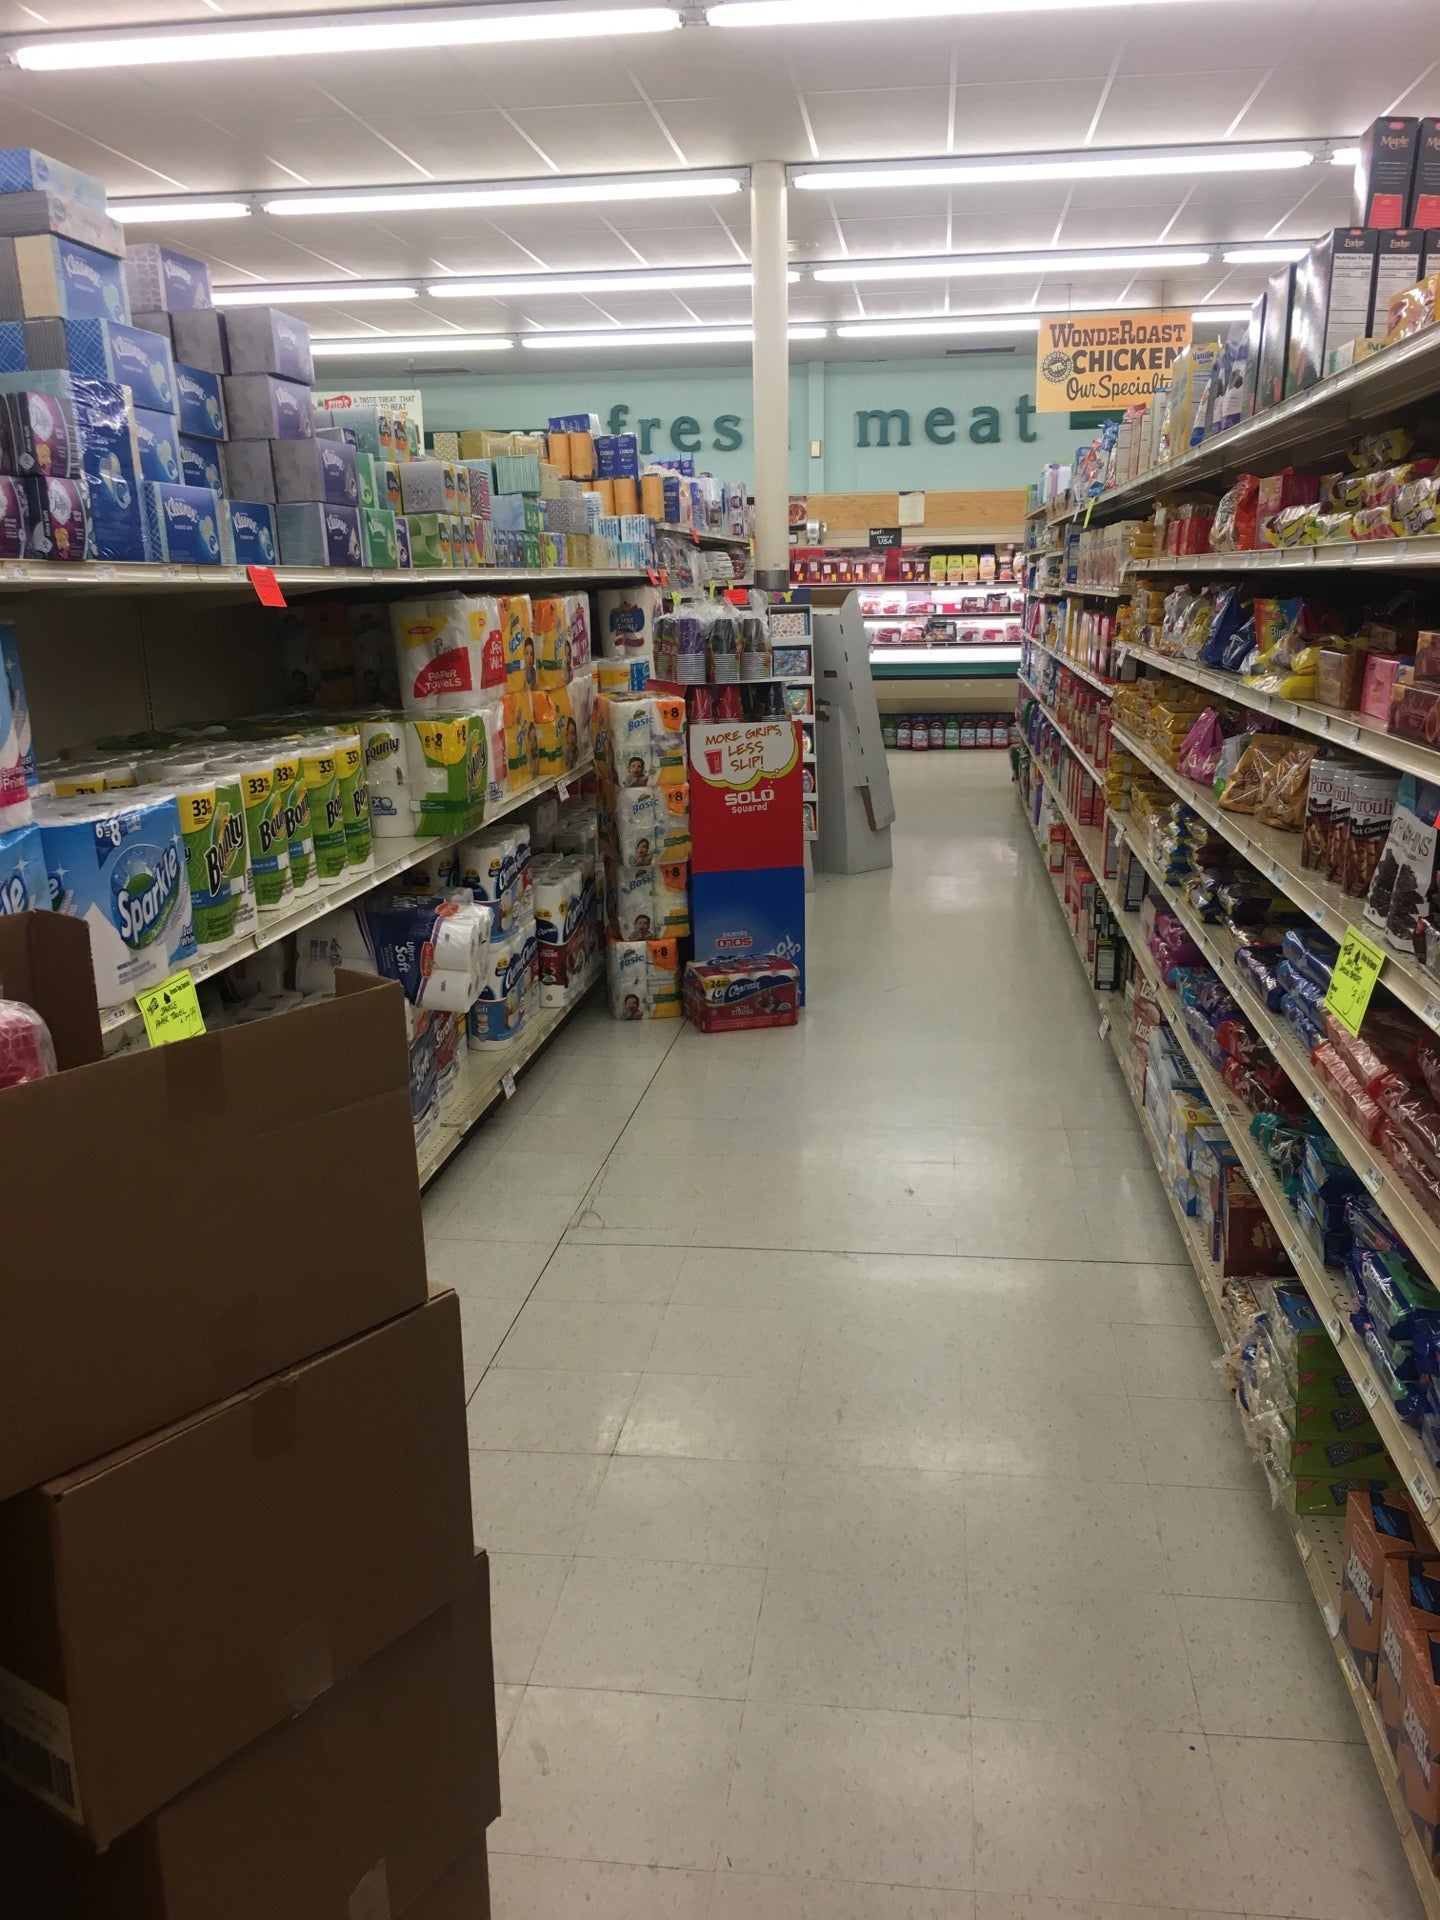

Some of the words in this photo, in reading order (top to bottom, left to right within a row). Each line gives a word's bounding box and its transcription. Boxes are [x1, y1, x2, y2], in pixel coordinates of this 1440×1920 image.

[1380, 136, 1410, 151] Maple
[1066, 376, 1098, 401] Our
[855, 393, 1037, 448] meat
[164, 497, 199, 523] Kleenex
[627, 715, 654, 732] Basic
[705, 730, 741, 746] MORE
[745, 725, 783, 739] GRIPS,
[728, 741, 764, 758] LESS
[730, 755, 764, 773] SLIP!
[632, 798, 659, 816] Basic
[724, 789, 775, 807] SOLO
[731, 803, 768, 815] squared
[204, 812, 245, 898] Bounty
[629, 874, 656, 891] Basic
[118, 847, 178, 945] Sparkle
[404, 941, 415, 962] Ultra
[716, 936, 753, 949] SOLO
[395, 944, 410, 974] Soft
[728, 981, 760, 998] Charmin
